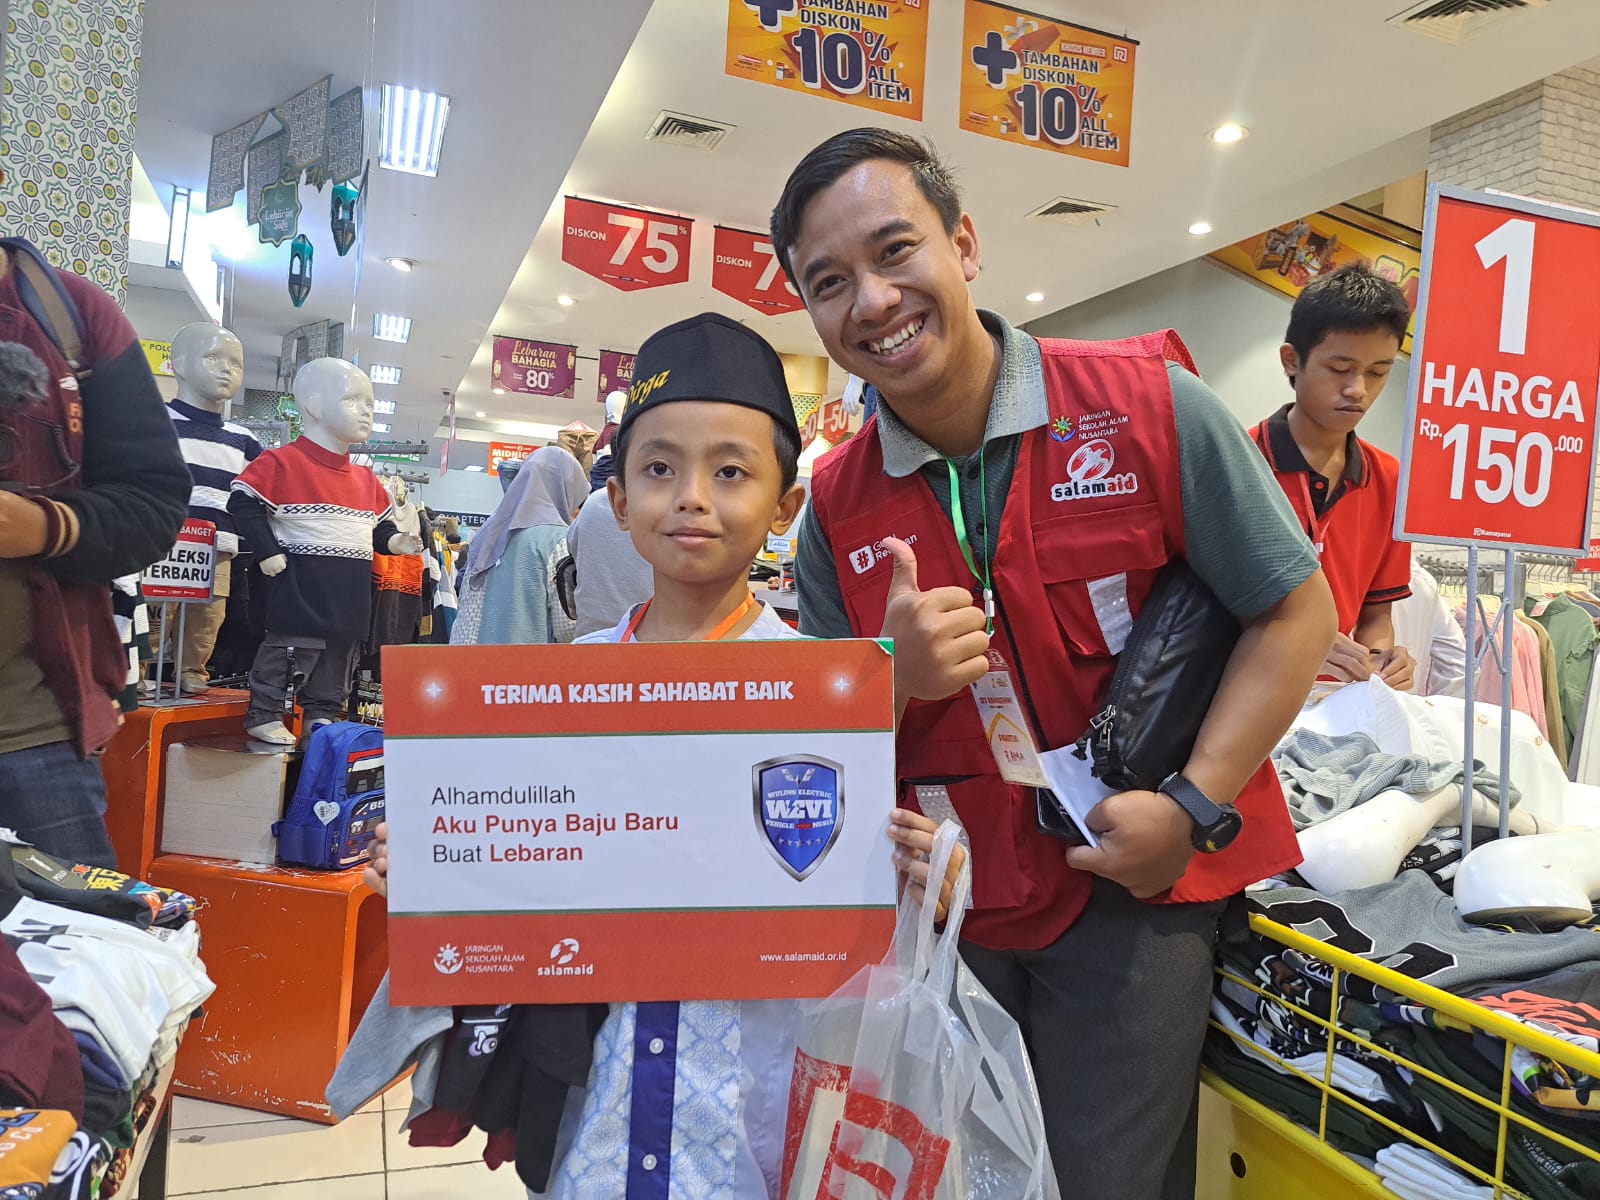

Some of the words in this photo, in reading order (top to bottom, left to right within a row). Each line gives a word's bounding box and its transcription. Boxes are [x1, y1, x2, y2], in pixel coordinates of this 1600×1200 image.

[800, 9, 861, 31] DISKON
[1023, 50, 1098, 73] TAMBAHAN
[868, 65, 900, 84] ALL
[1023, 67, 1075, 85] DISKON
[868, 82, 911, 102] ITEM
[1081, 116, 1109, 133] ALL
[1081, 132, 1117, 150] ITEM
[567, 226, 606, 241] DISKON
[716, 254, 752, 269] DISKON
[1475, 219, 1536, 355] 1
[512, 340, 557, 359] Lebaran
[512, 354, 557, 369] BAHAGIA
[1422, 362, 1585, 423] HARGA
[1078, 409, 1111, 423] JARINGAN
[1078, 420, 1107, 431] SEKOLAH
[1109, 415, 1129, 425] ALAM
[1078, 427, 1119, 440] NUSANTARA
[492, 448, 533, 459] MIDNIG
[1054, 475, 1135, 498] salamaid
[168, 549, 210, 566] LEKSI
[481, 684, 563, 705] TERIMA
[568, 683, 633, 704] KASIH
[639, 681, 738, 703] SAHABAT
[744, 680, 794, 701] BAIK
[431, 786, 576, 805] Alhamdulillah
[767, 789, 797, 799] WULING
[797, 789, 832, 799] ELECTRIC
[432, 815, 477, 834] Aku
[485, 814, 557, 837] Punya
[565, 813, 616, 836] Baju
[625, 812, 679, 831] Baru
[765, 819, 795, 829] VEHICLE
[433, 844, 482, 863] Buat
[489, 843, 583, 862] Lebaran
[465, 945, 503, 954] JARINGAN
[760, 951, 847, 962] www.salamaid.or.id
[465, 955, 501, 963] SEKOLAH
[502, 954, 525, 962] ALAM
[465, 964, 514, 973] NUSANTARA
[537, 963, 594, 976] salamaid
